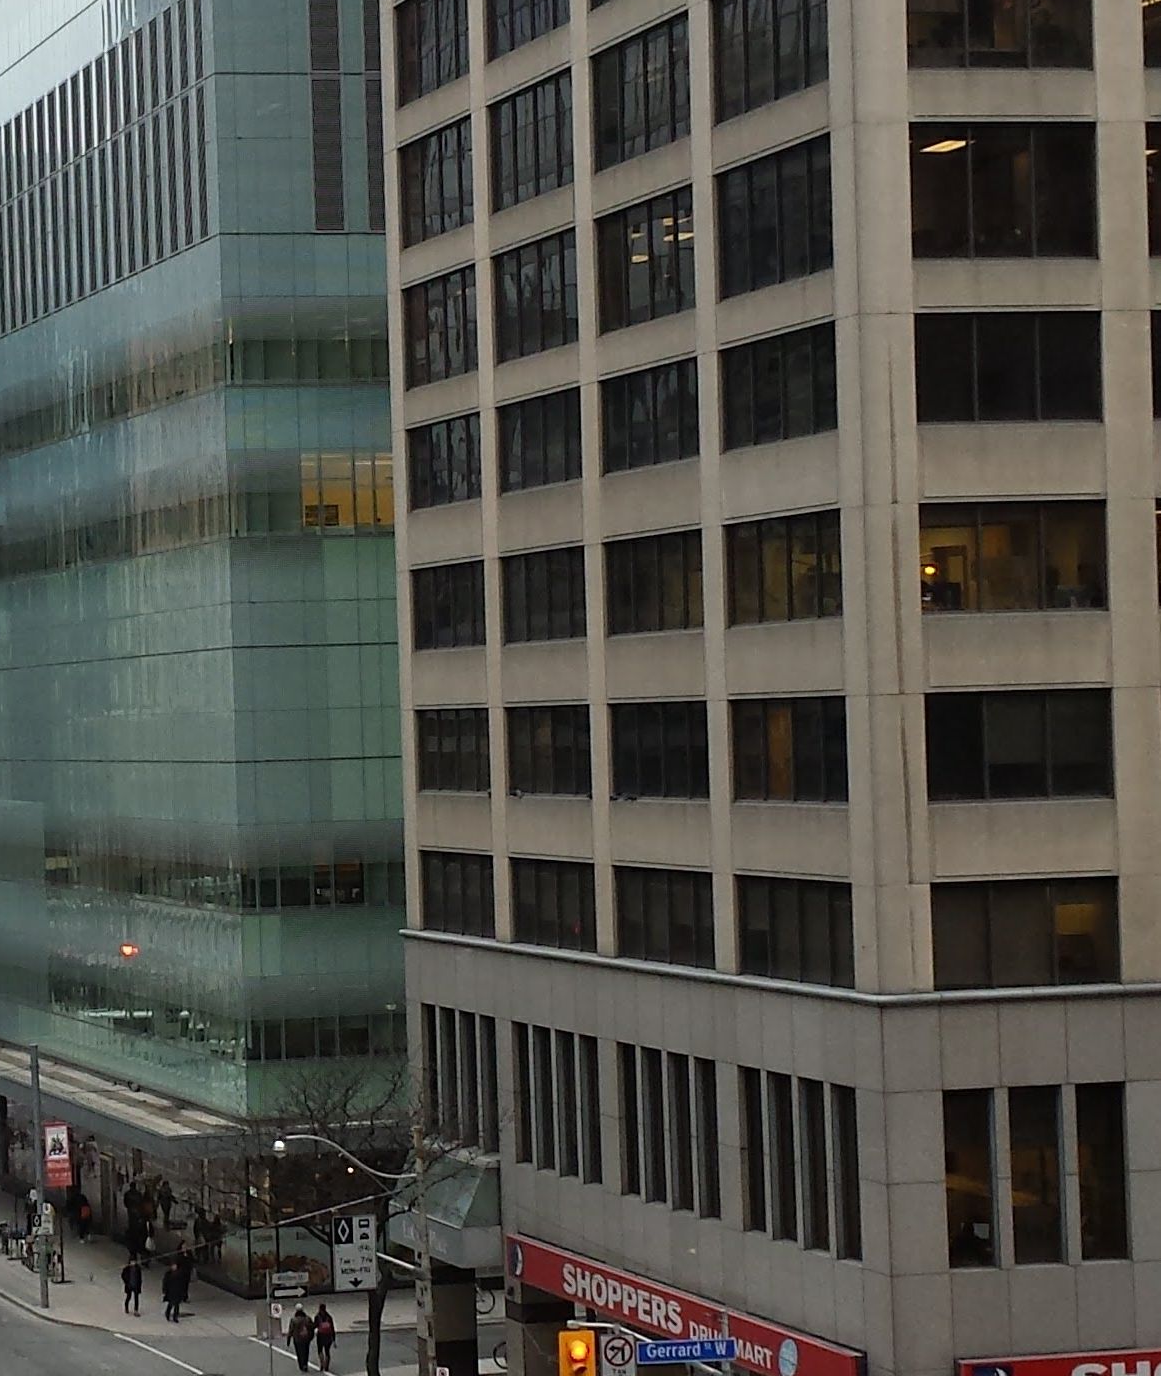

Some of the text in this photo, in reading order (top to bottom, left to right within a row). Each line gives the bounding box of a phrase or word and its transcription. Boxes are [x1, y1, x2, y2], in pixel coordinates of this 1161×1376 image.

[562, 1262, 683, 1335] SHOPPERS
[646, 1341, 701, 1359] Gerrard
[715, 1340, 727, 1355] W
